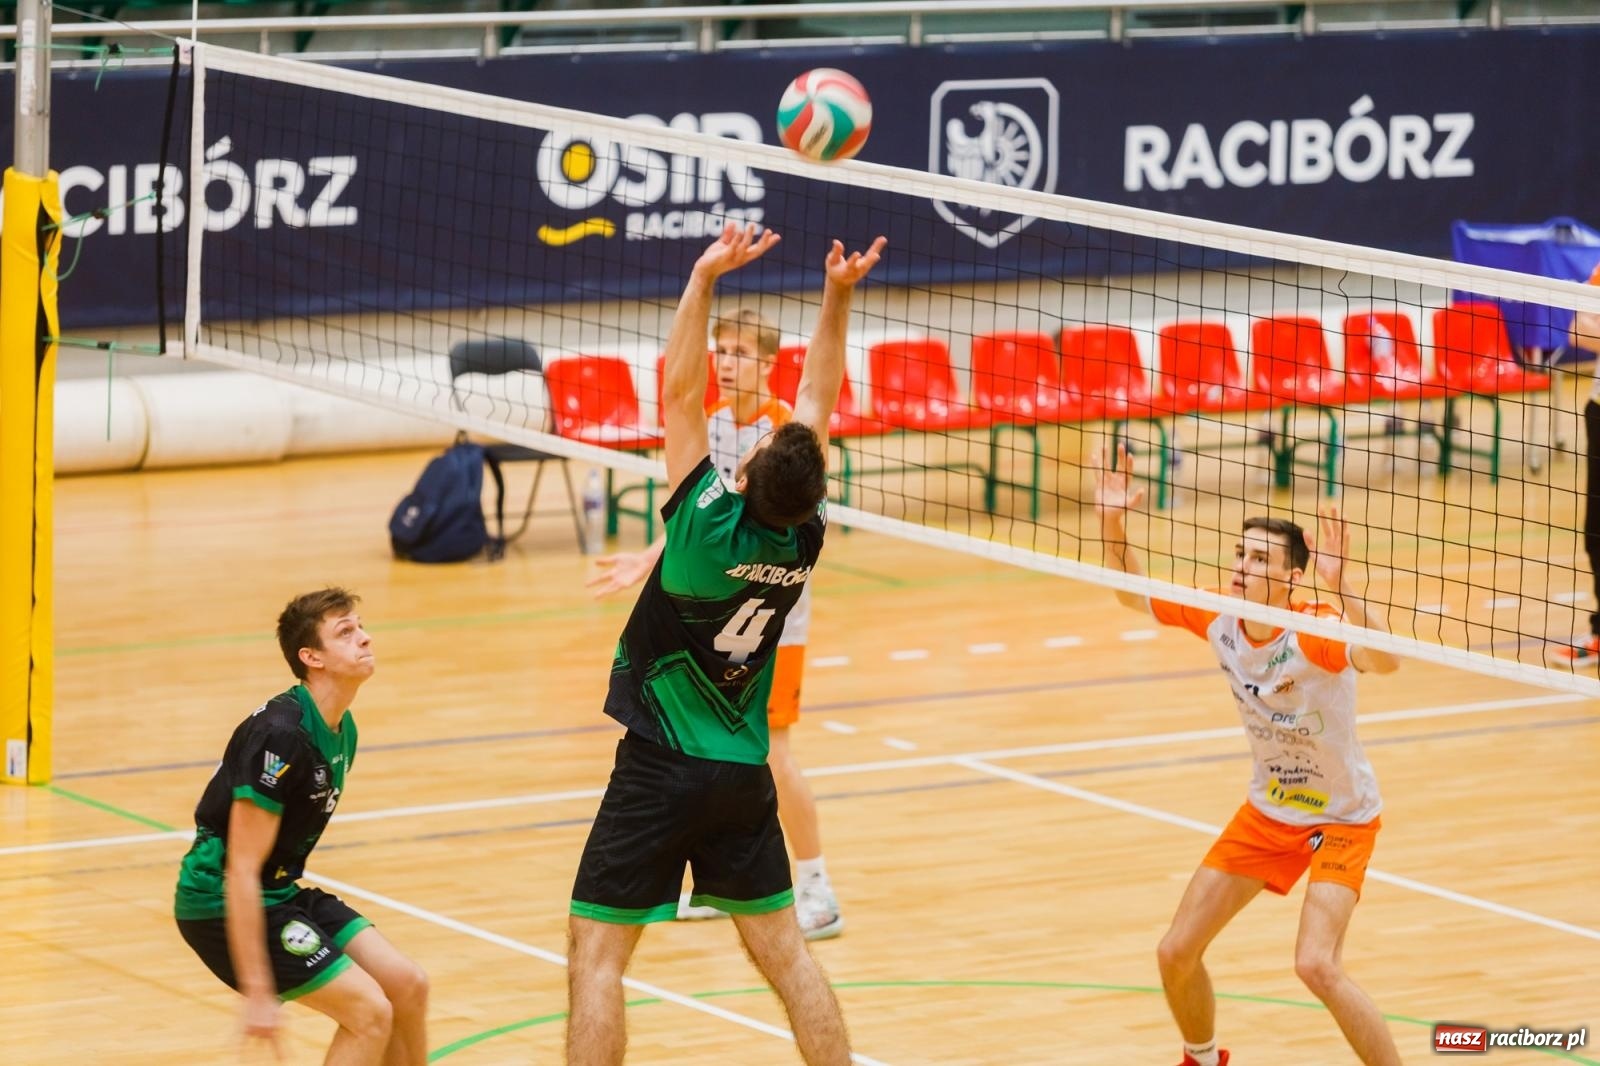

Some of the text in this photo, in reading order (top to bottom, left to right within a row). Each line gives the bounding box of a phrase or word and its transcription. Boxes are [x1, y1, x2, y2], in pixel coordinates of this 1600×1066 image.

[0, 135, 358, 238] CIBÓRZ
[1124, 94, 1475, 191] RACIBÓRZ
[713, 598, 776, 663] 4
